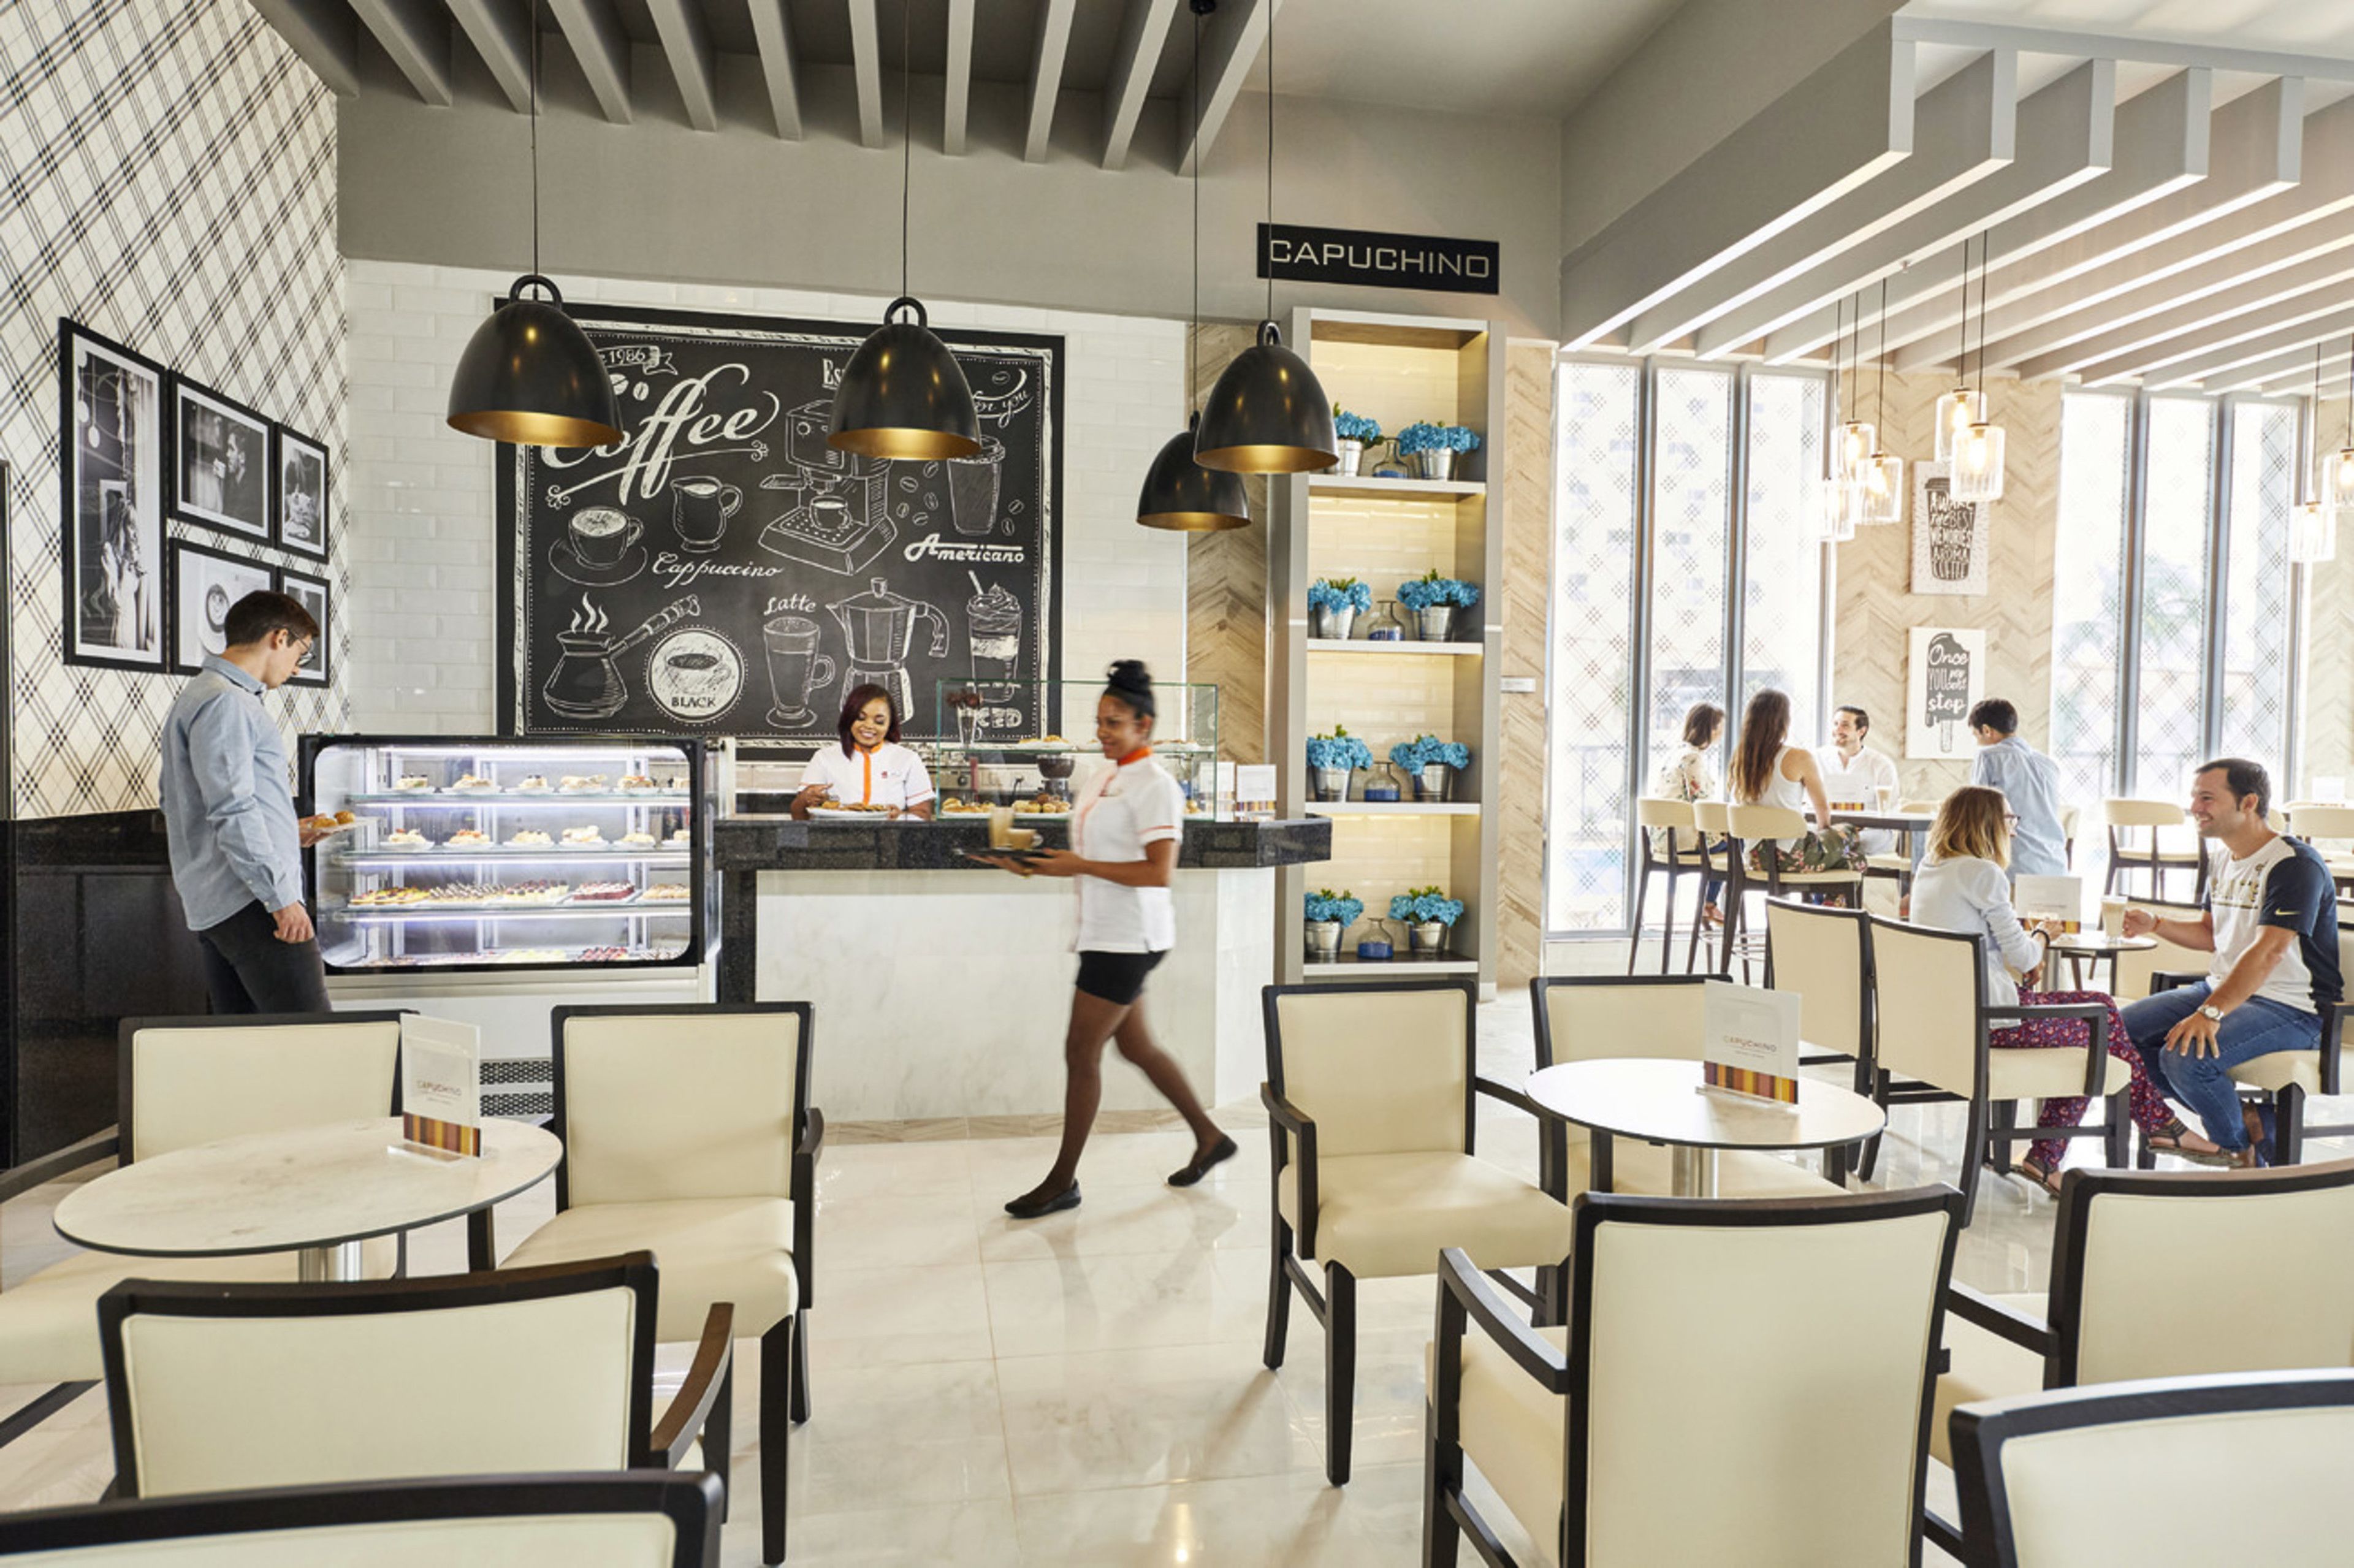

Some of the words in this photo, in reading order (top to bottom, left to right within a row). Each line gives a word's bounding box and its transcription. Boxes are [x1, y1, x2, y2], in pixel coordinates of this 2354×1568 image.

[1270, 240, 1490, 279] CAPUCHINO
[609, 348, 646, 365] 1986
[997, 389, 1029, 429] you
[904, 533, 1026, 563] Americano
[652, 552, 784, 590] Cappuccino
[763, 593, 818, 616] Latte
[1929, 643, 1969, 666] Once
[670, 695, 717, 709] BLACK
[1927, 691, 1966, 715] stop
[977, 707, 1023, 729] CED
